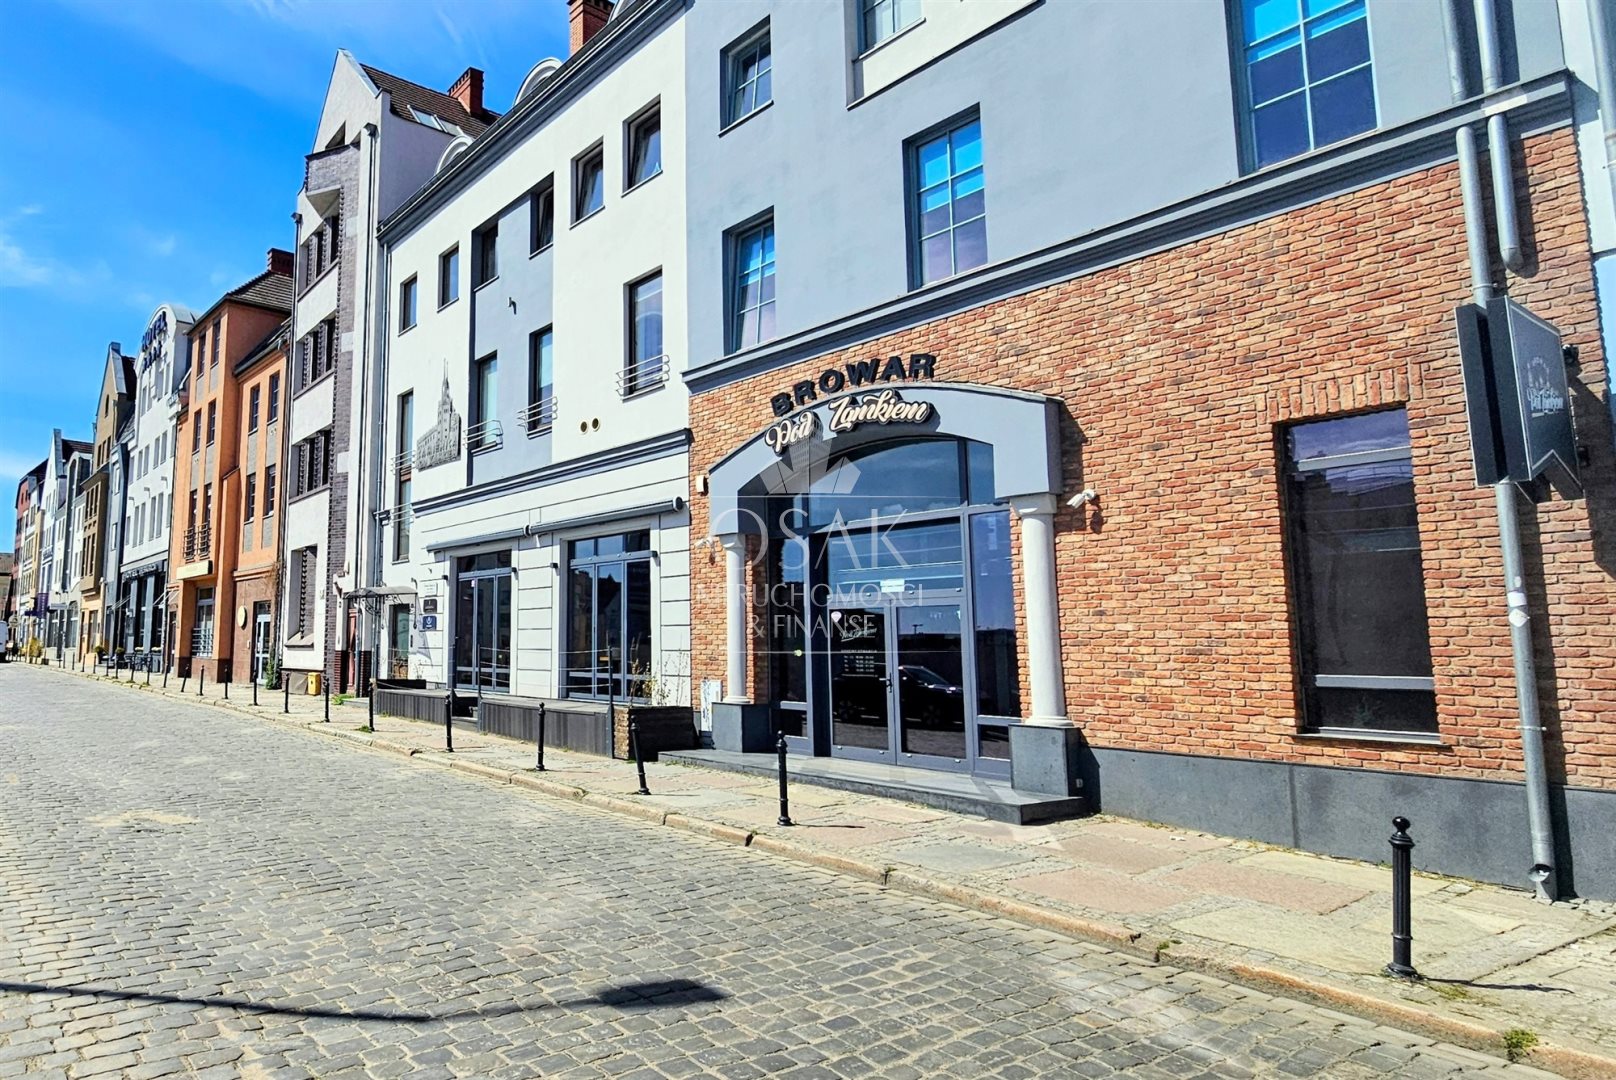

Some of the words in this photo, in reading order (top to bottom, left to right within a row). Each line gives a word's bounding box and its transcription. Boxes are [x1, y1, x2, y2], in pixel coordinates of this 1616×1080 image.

[770, 353, 937, 417] BROWAR
[765, 410, 815, 454] Pod
[829, 387, 930, 433] Zamkiem
